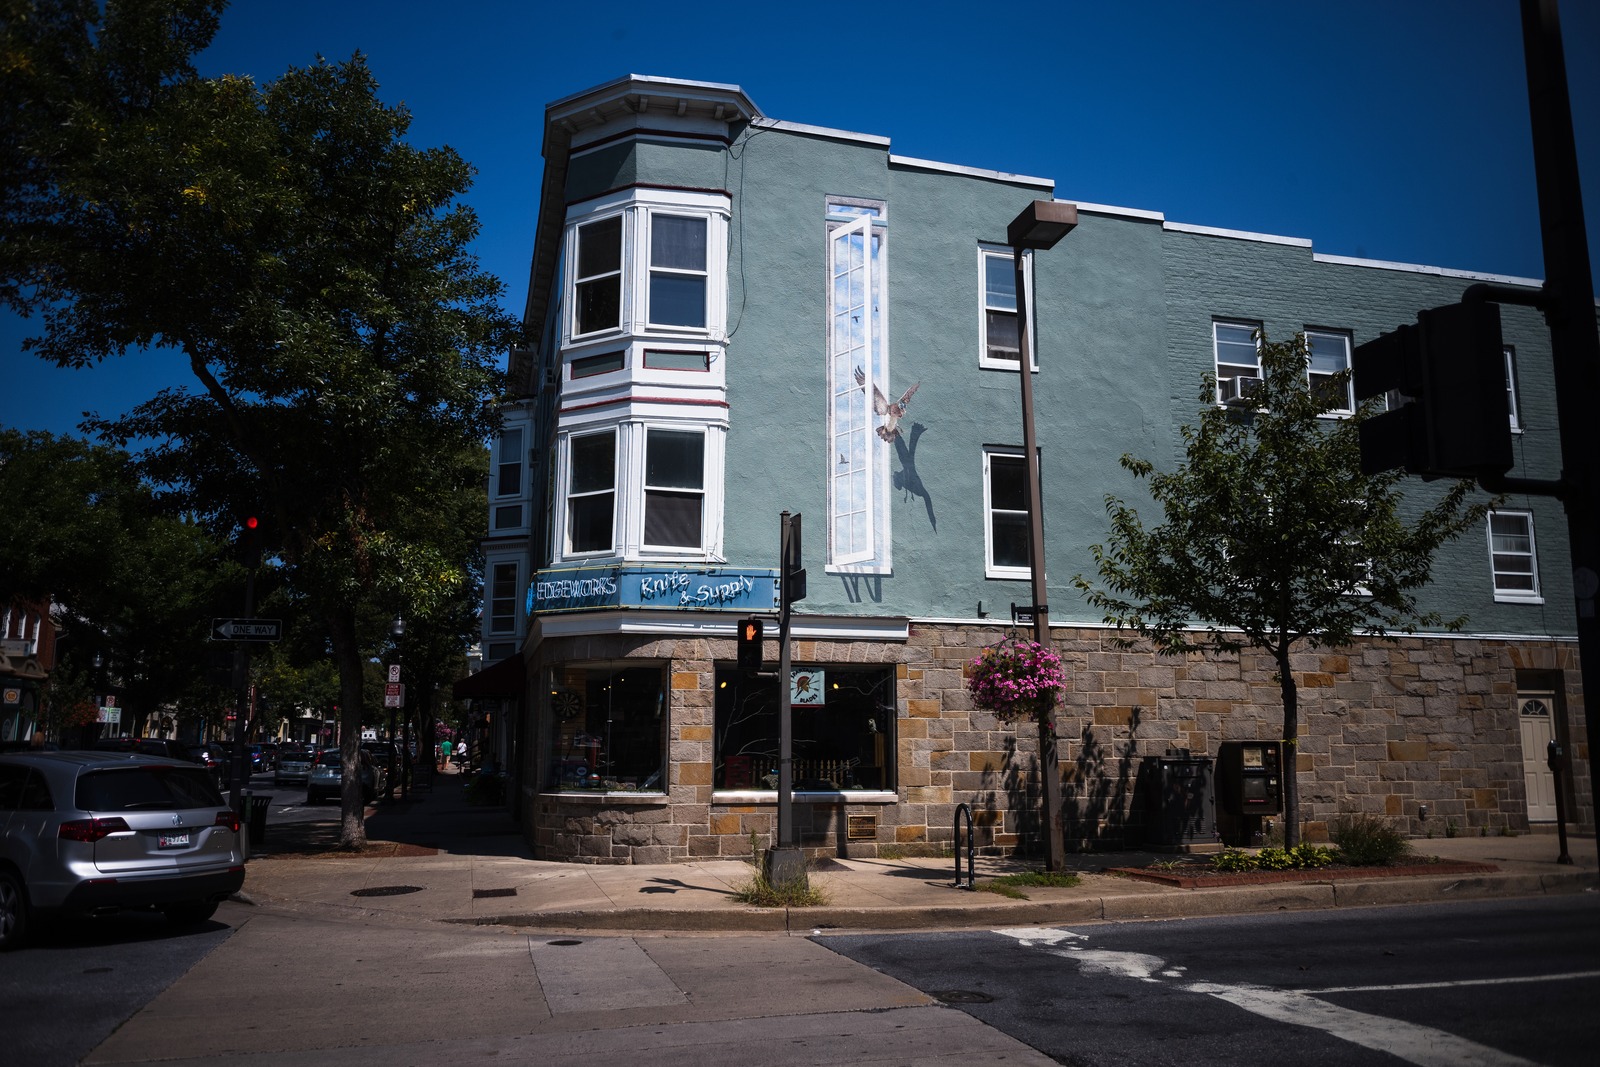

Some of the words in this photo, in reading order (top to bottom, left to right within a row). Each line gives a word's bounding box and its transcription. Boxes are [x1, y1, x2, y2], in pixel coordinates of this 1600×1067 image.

[537, 577, 617, 600] EDGEWORKS
[641, 570, 690, 595] Knife
[680, 590, 698, 604] &
[697, 575, 755, 601] Supply
[232, 625, 252, 634] ONE
[254, 626, 274, 635] WAY
[800, 693, 818, 704] BLADES
